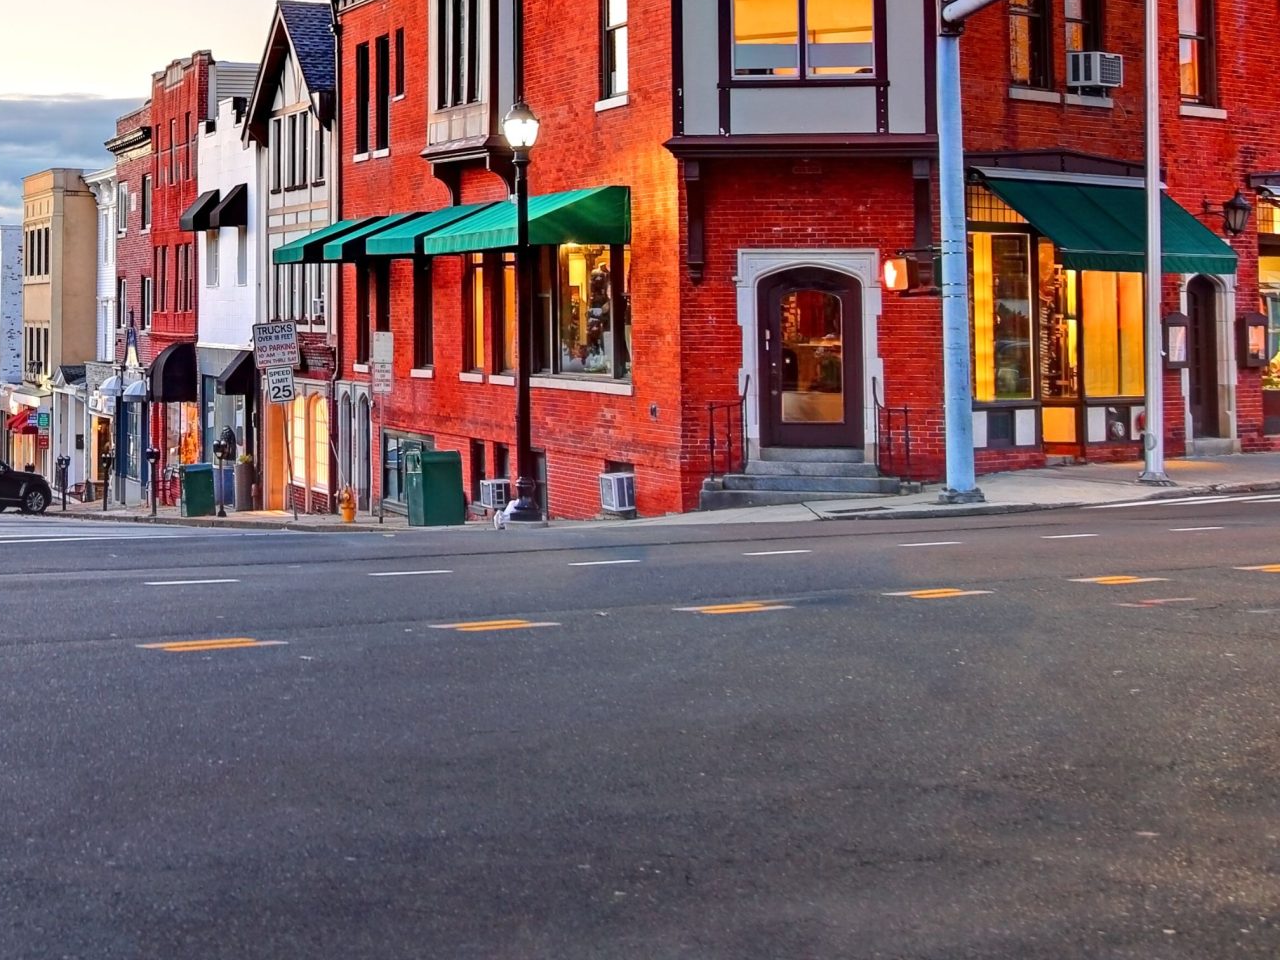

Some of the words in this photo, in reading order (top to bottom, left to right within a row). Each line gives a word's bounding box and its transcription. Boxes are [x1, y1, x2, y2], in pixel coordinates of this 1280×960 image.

[257, 324, 292, 335] TRUCKS
[257, 335, 273, 343] OVER
[281, 333, 293, 341] FEET
[257, 345, 267, 353] NO
[269, 343, 295, 351] PARKING
[272, 385, 292, 399] 25
